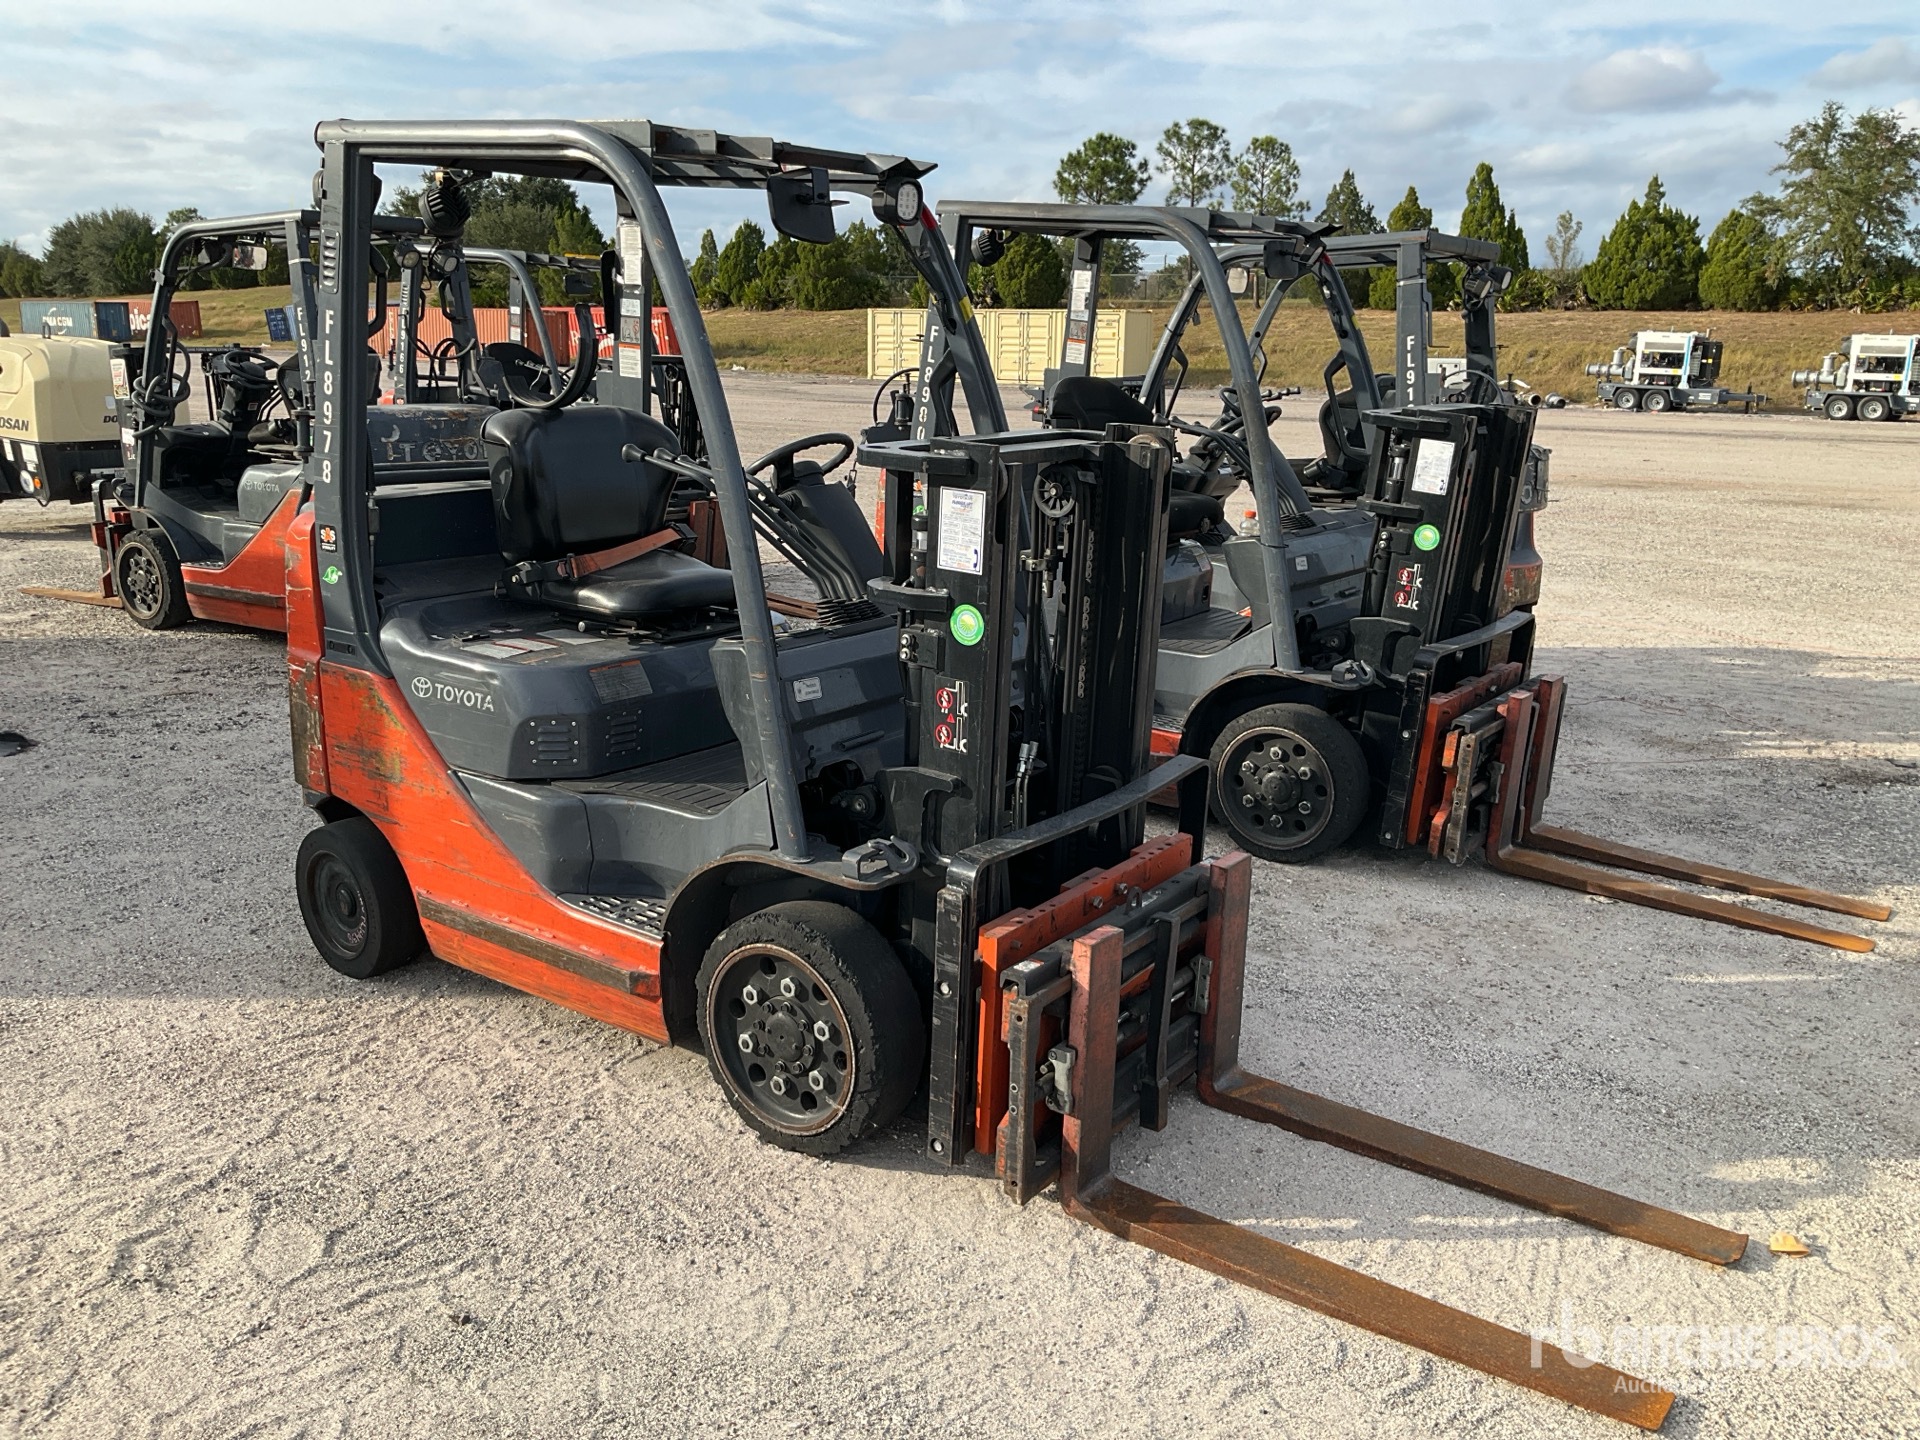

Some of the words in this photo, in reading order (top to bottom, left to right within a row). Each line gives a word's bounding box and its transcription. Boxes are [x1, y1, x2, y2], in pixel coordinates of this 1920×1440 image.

[322, 309, 334, 484] FL8978
[1406, 335, 1416, 408] FL91
[253, 481, 280, 493] TOYOTA
[434, 683, 494, 712] TOYOTA
